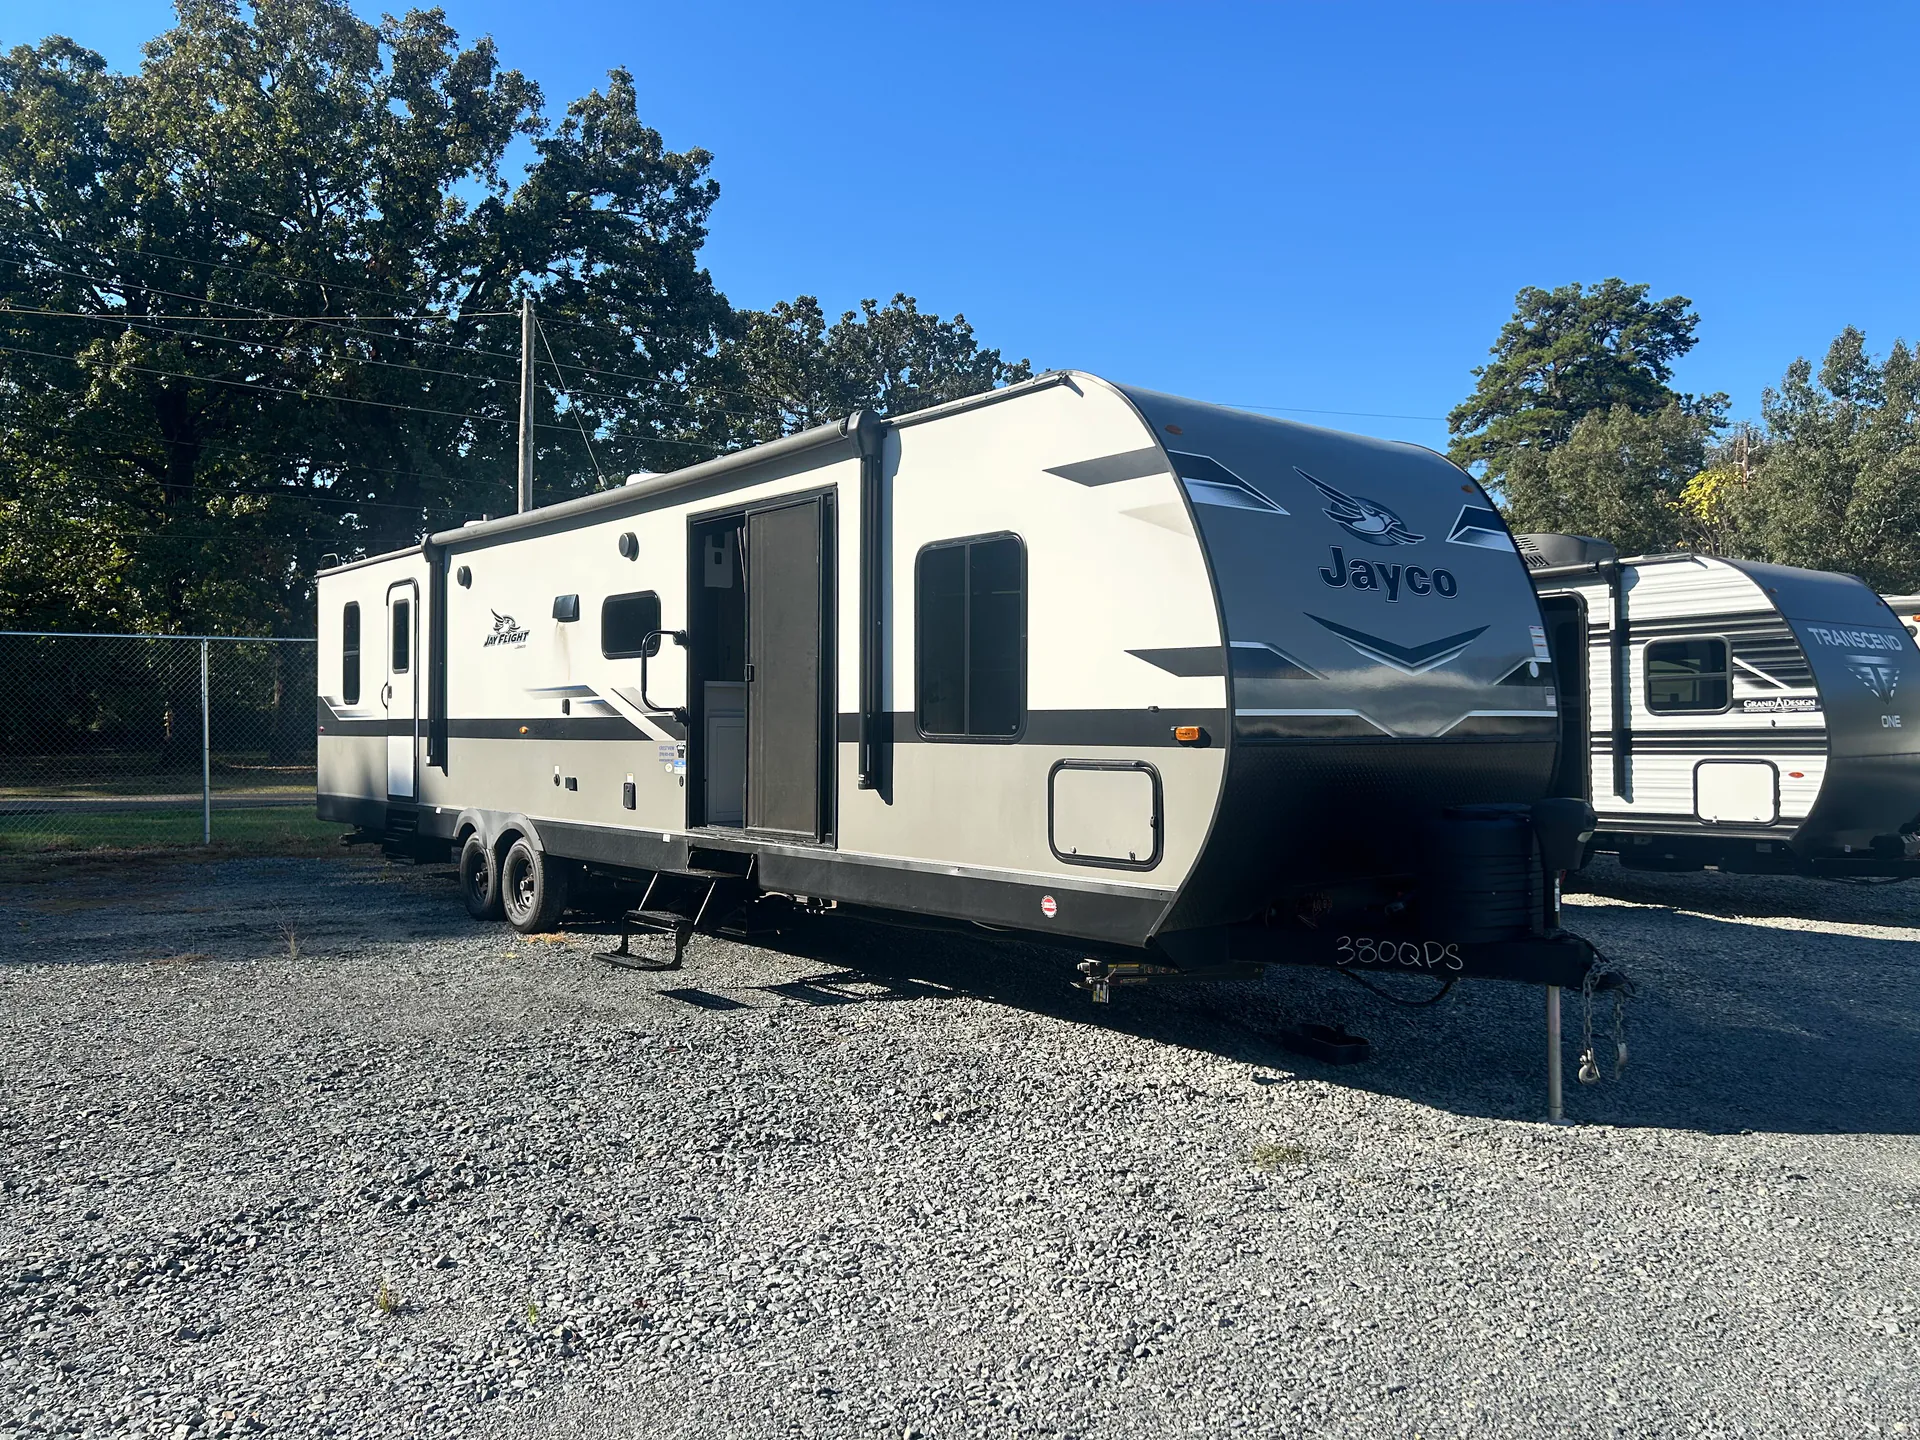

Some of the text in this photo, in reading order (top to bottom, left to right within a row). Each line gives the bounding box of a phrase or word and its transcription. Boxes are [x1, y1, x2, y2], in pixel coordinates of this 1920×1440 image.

[1318, 545, 1458, 602] Jayco
[497, 630, 530, 645] FLIGHT
[1807, 627, 1903, 651] TRANSCEND
[1743, 700, 1776, 708] GRAND
[1881, 715, 1902, 728] ONE
